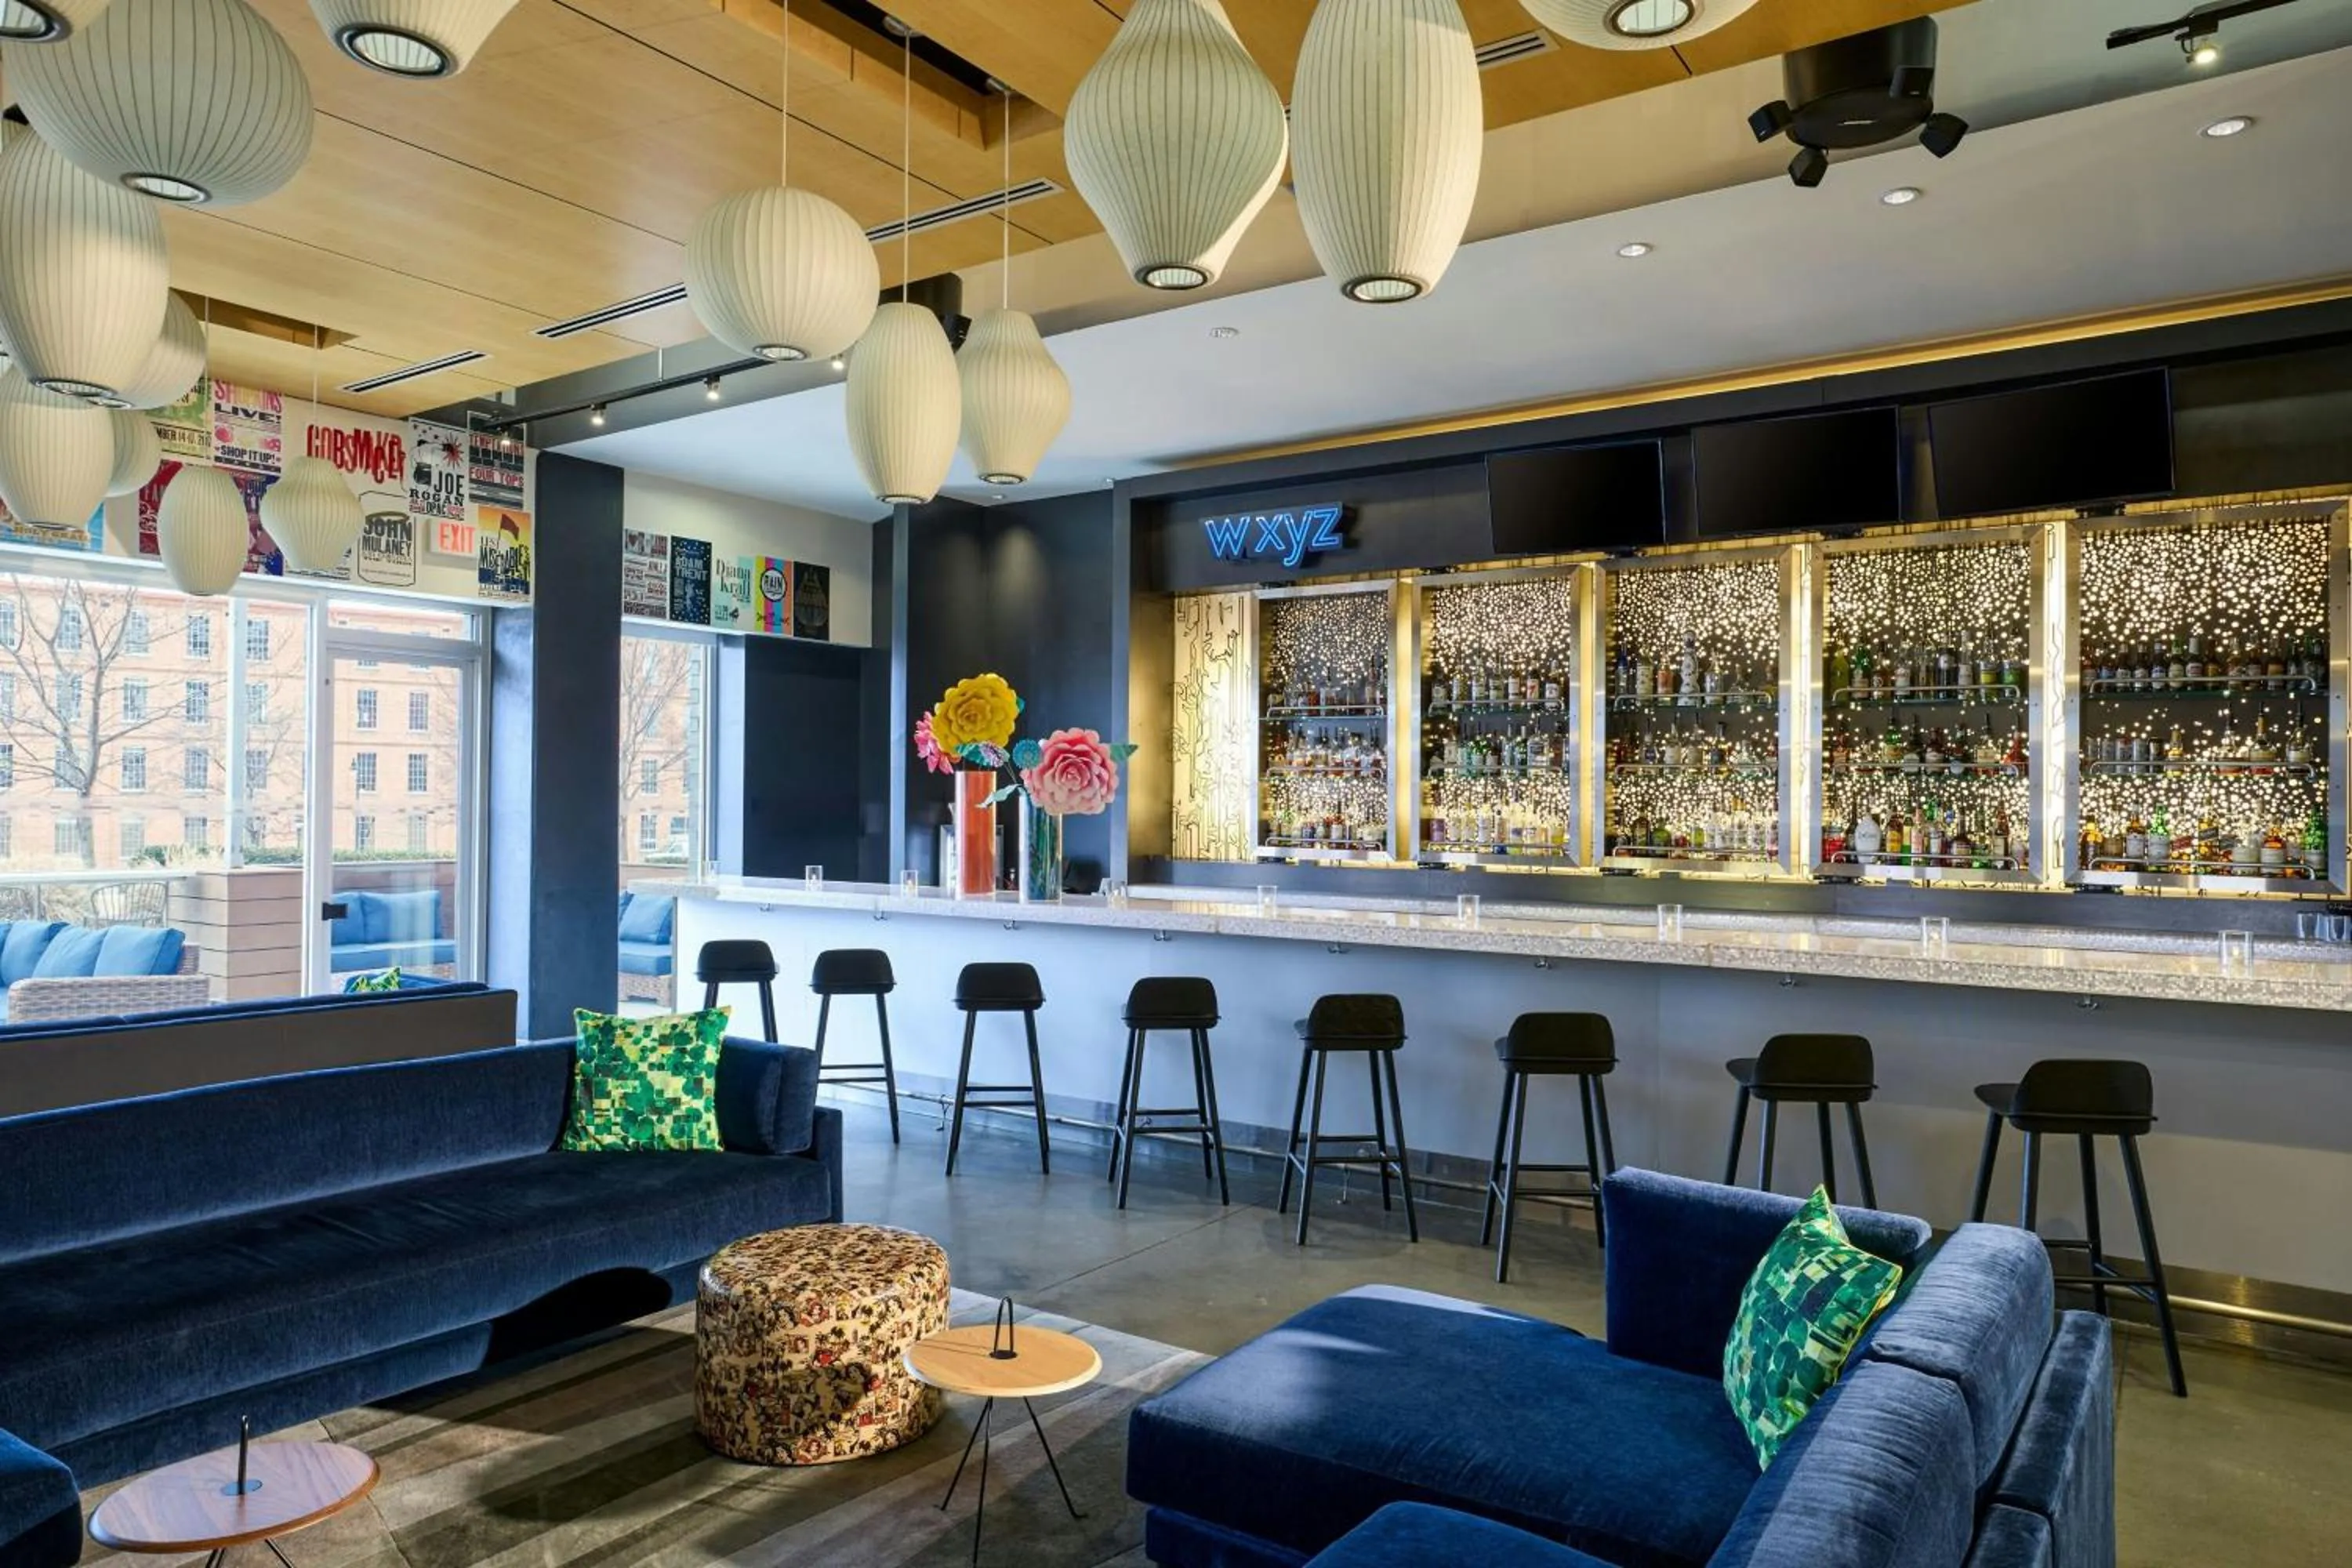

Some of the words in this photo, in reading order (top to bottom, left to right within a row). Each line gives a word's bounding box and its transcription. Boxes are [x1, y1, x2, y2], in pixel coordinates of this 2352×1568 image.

[215, 403, 281, 423] LIVE!
[220, 445, 247, 459] SHOP
[249, 448, 258, 461] IT
[260, 450, 275, 464] UP!
[434, 470, 464, 497] JOE
[409, 488, 464, 506] ROGAN
[364, 517, 412, 541] JOHN
[438, 521, 475, 554] EXIT
[363, 535, 412, 557] MULANEY
[675, 556, 703, 570] ADAM
[716, 559, 750, 579] Diana
[675, 568, 708, 580] TRENT
[764, 575, 782, 588] RAIN
[720, 576, 750, 597] Krall
